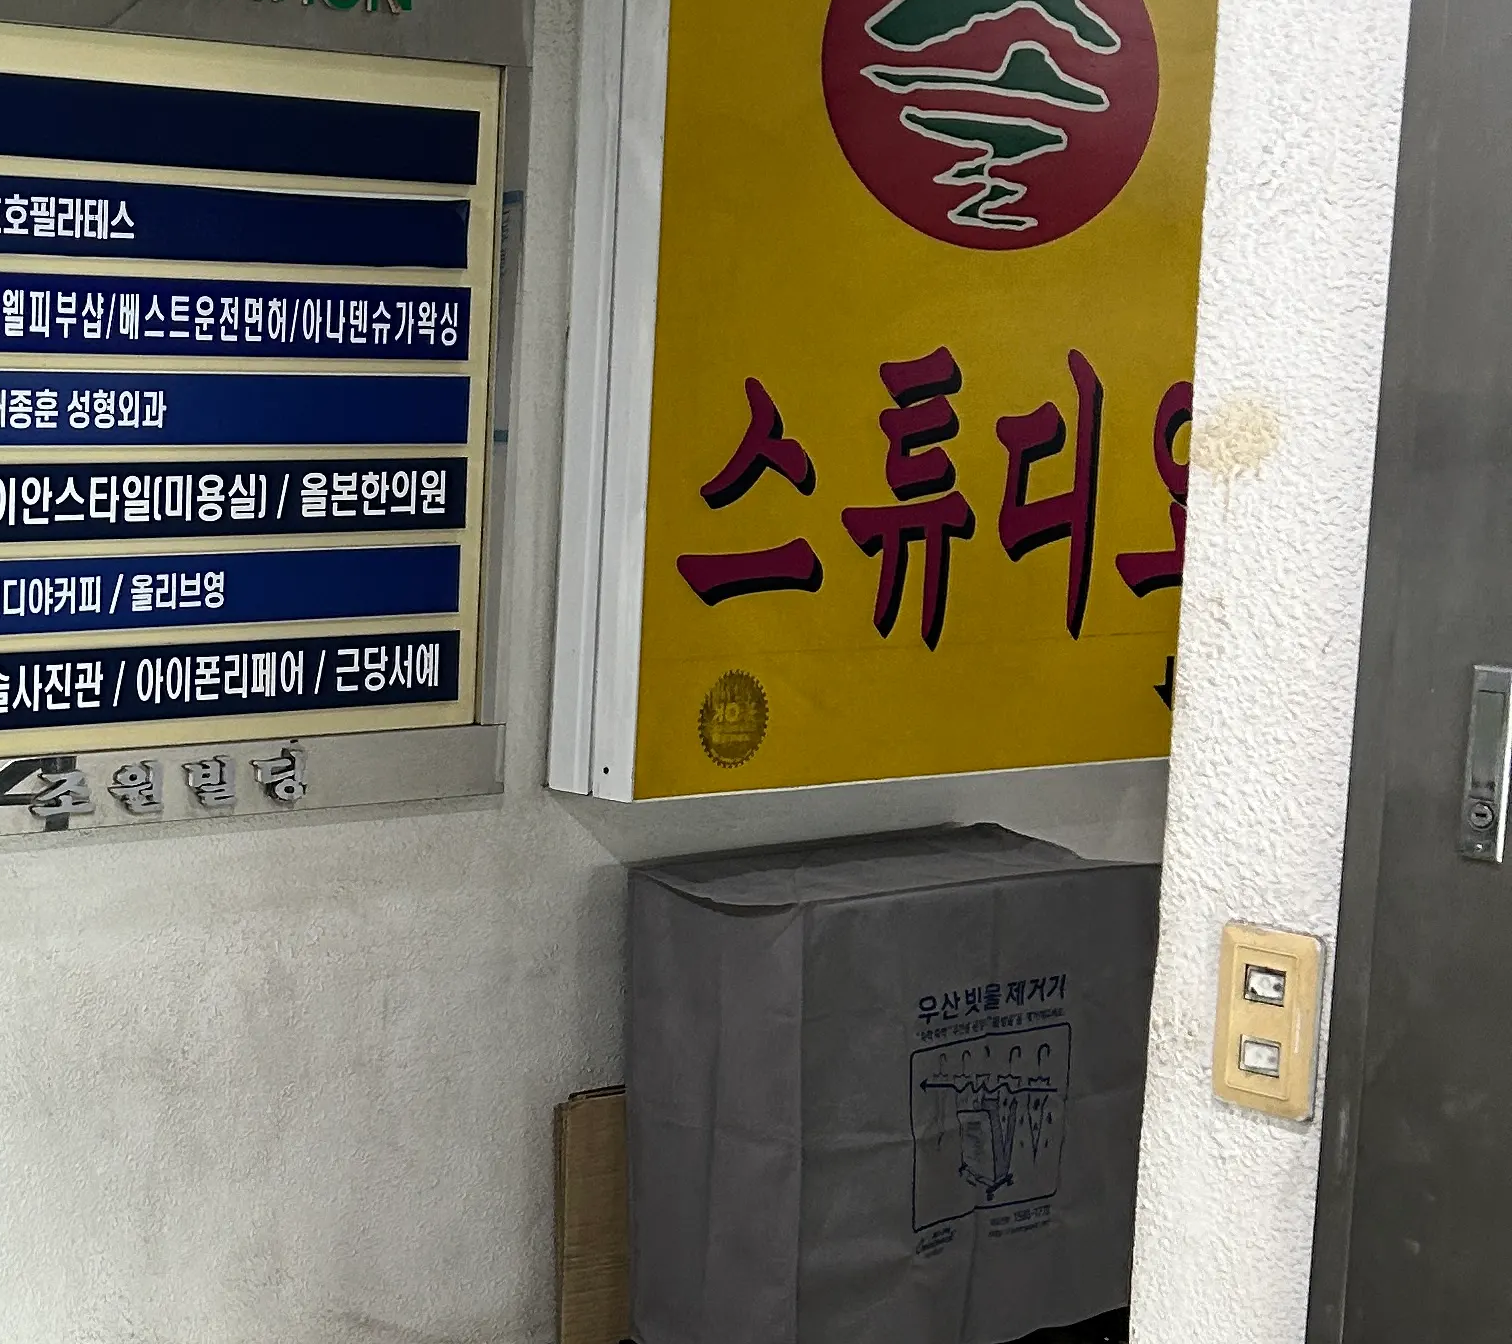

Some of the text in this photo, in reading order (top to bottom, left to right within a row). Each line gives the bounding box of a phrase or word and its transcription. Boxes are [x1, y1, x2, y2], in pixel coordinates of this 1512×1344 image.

[67, 388, 167, 429] 성형외과
[300, 470, 446, 518] 올본한의원
[130, 571, 225, 610] 올리브영
[136, 652, 304, 704] 아이폰리페어
[336, 643, 440, 692] 근당서예
[918, 991, 960, 1025] 우산
[1005, 974, 1067, 1006] 제거기
